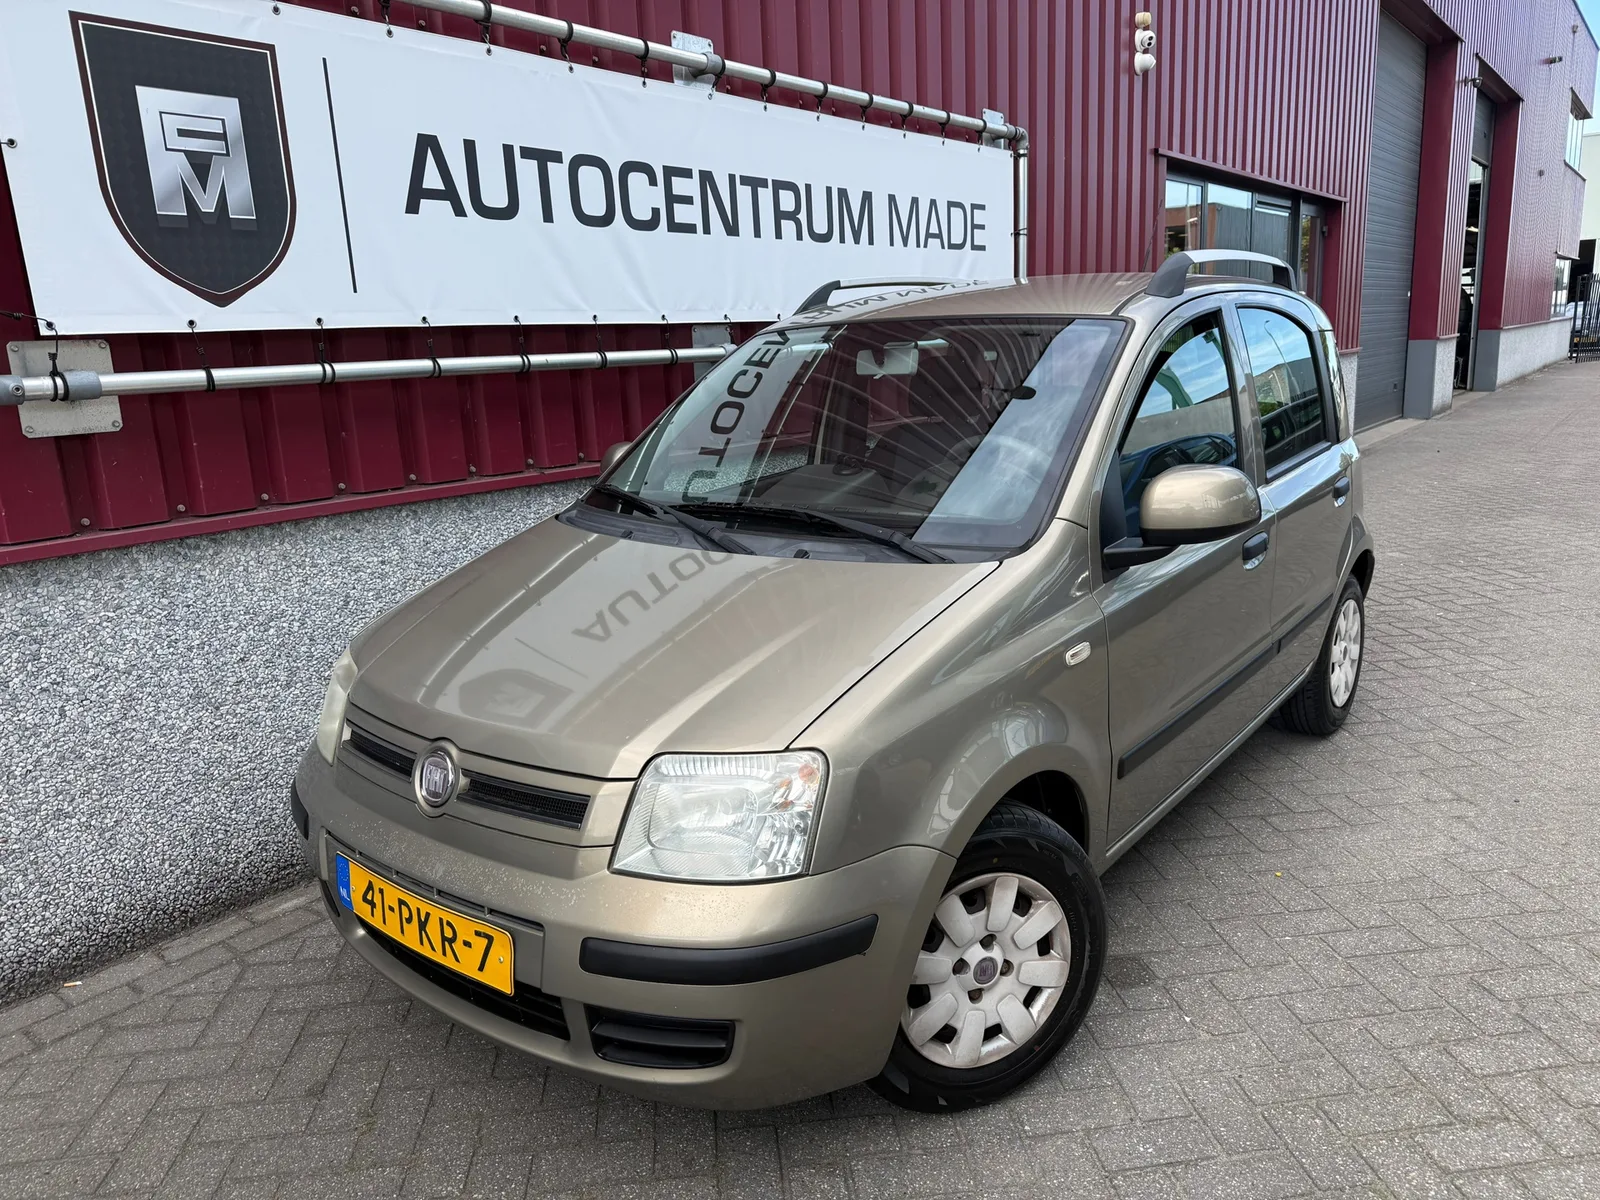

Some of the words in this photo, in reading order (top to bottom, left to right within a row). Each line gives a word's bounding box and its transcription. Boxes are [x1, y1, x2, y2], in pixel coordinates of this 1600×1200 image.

[404, 132, 875, 246] AUTOCENTRUM
[887, 193, 987, 252] MADE
[339, 885, 350, 901] NL
[362, 879, 494, 973] 41-PKR-7
